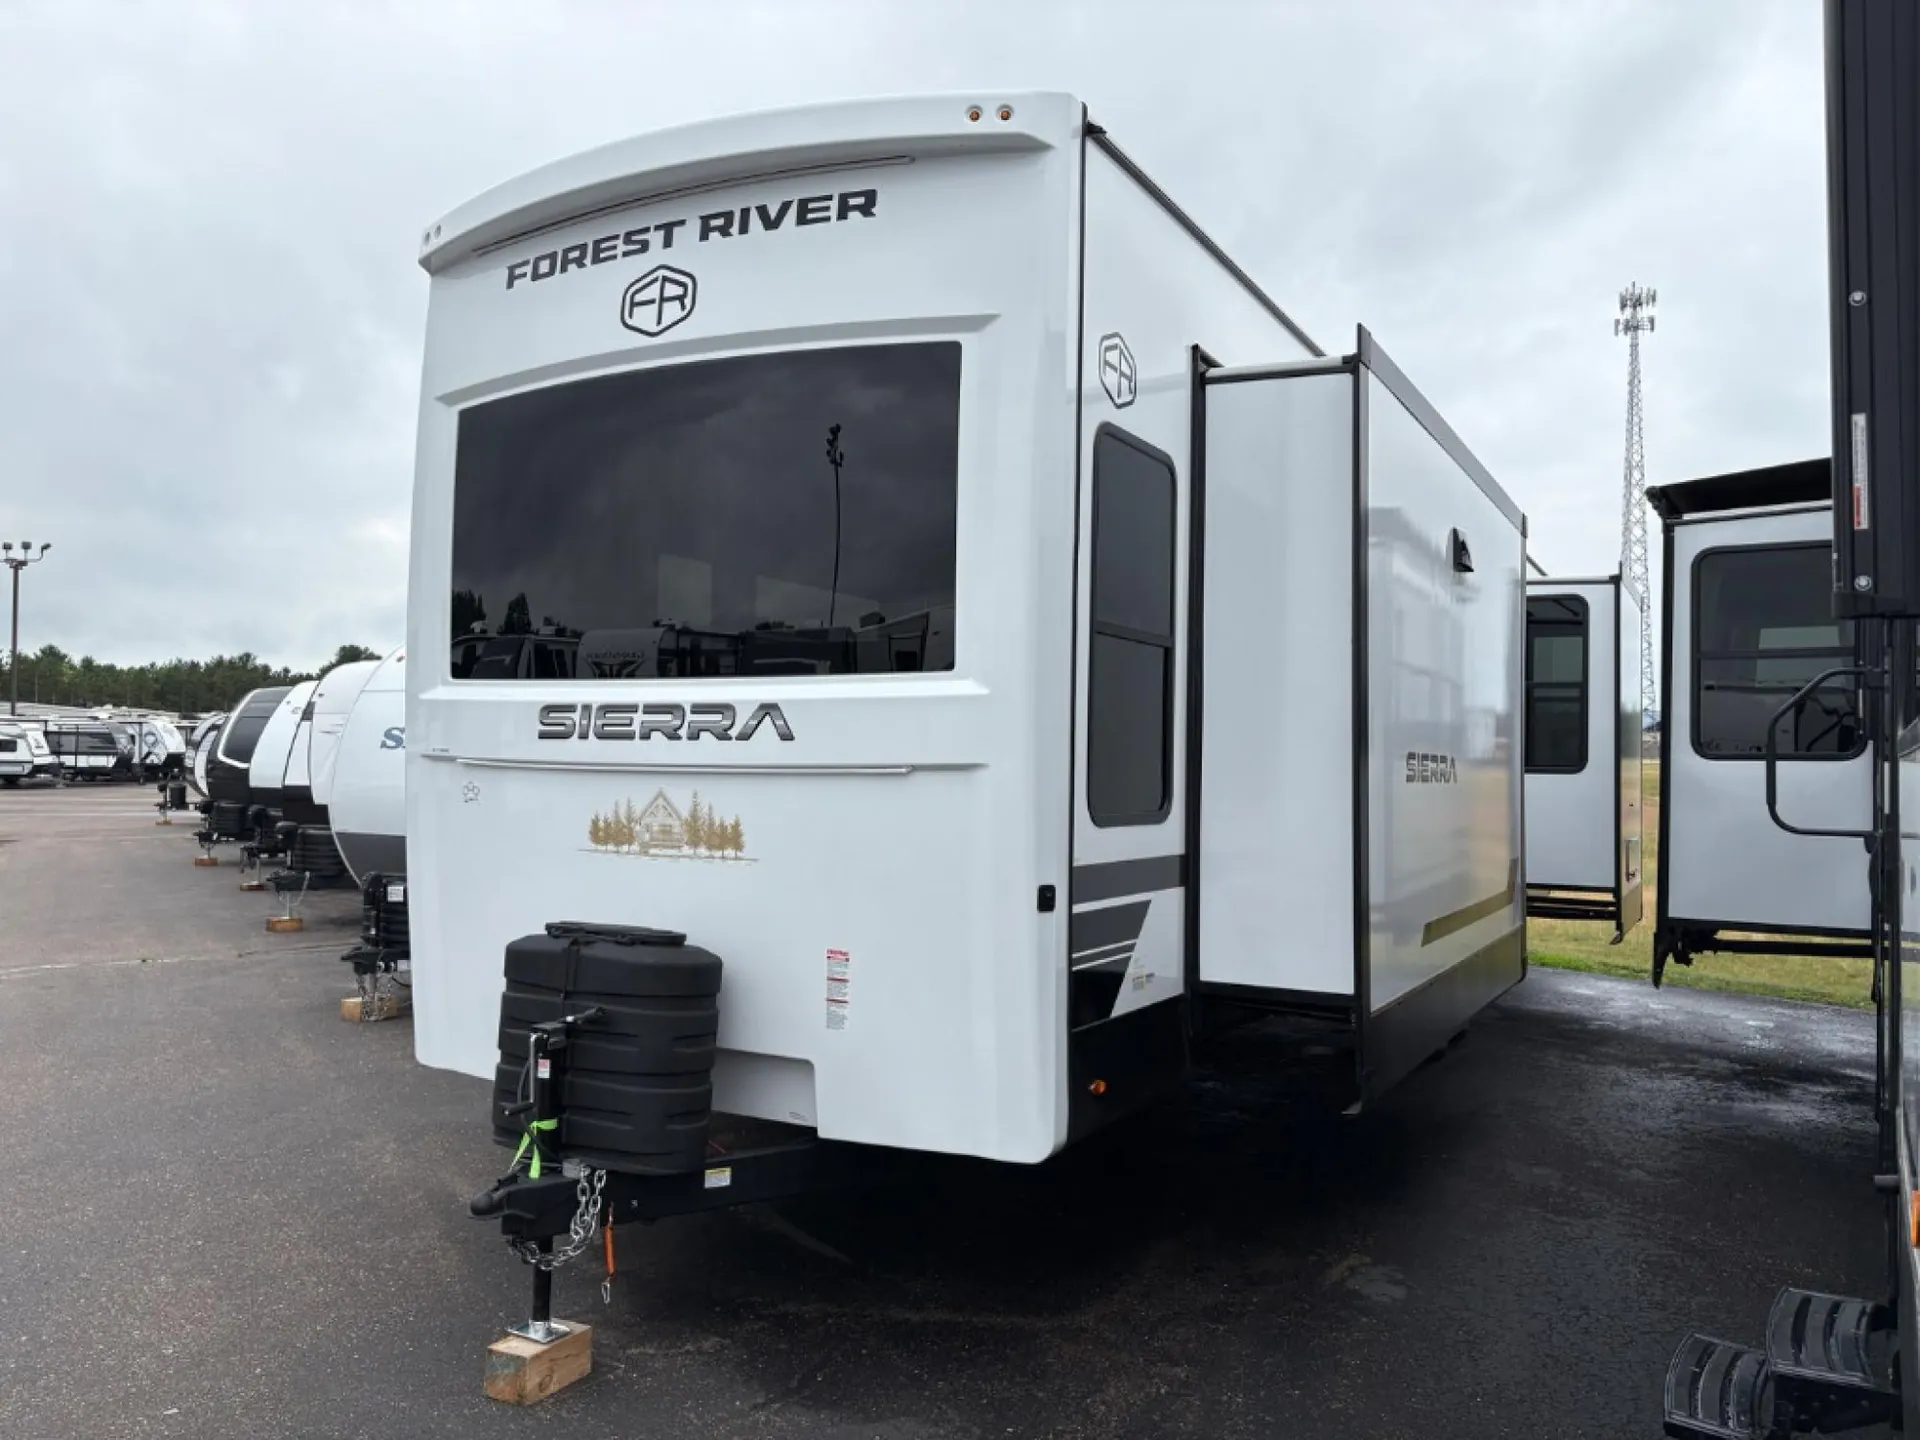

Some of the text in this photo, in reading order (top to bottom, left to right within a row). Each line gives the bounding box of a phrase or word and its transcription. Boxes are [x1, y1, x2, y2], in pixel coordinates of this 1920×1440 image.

[506, 188, 878, 289] FOREST RIVER
[537, 702, 796, 741] SIERRA
[1406, 751, 1458, 783] SIERRA
